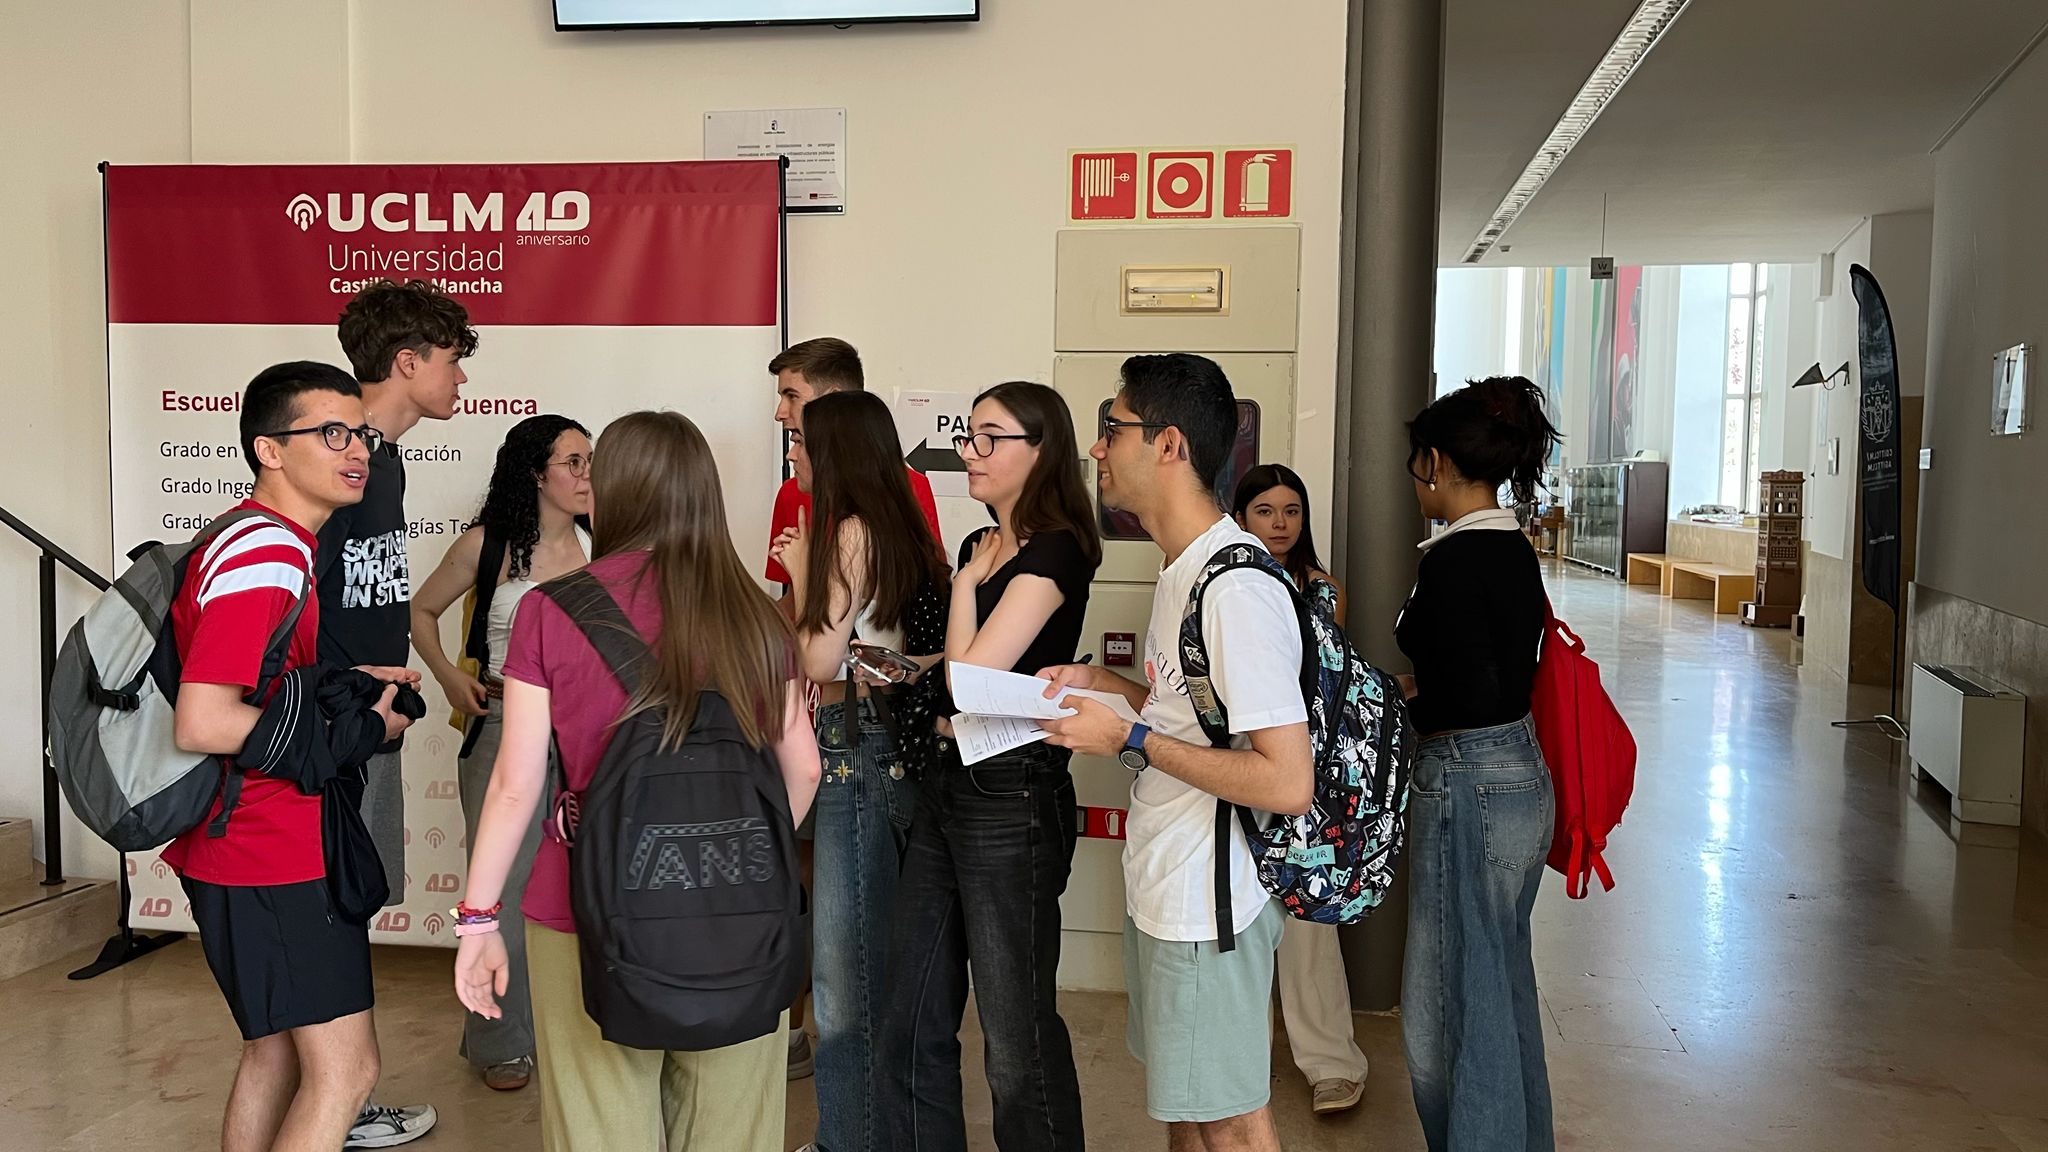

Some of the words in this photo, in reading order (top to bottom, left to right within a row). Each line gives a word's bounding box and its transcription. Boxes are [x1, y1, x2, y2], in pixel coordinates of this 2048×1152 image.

[327, 192, 504, 232] UCLM
[515, 190, 590, 231] 40
[516, 234, 590, 246] aniversario
[328, 243, 504, 271] Universidad
[432, 277, 503, 294] Mancha
[937, 415, 972, 433] PA
[160, 442, 211, 458] Grado
[216, 446, 238, 458] en
[161, 478, 212, 494] Grado
[342, 585, 372, 608] IN
[425, 781, 457, 800] 40
[425, 873, 460, 893] 40
[138, 897, 173, 918] 40
[375, 911, 411, 933] 40
